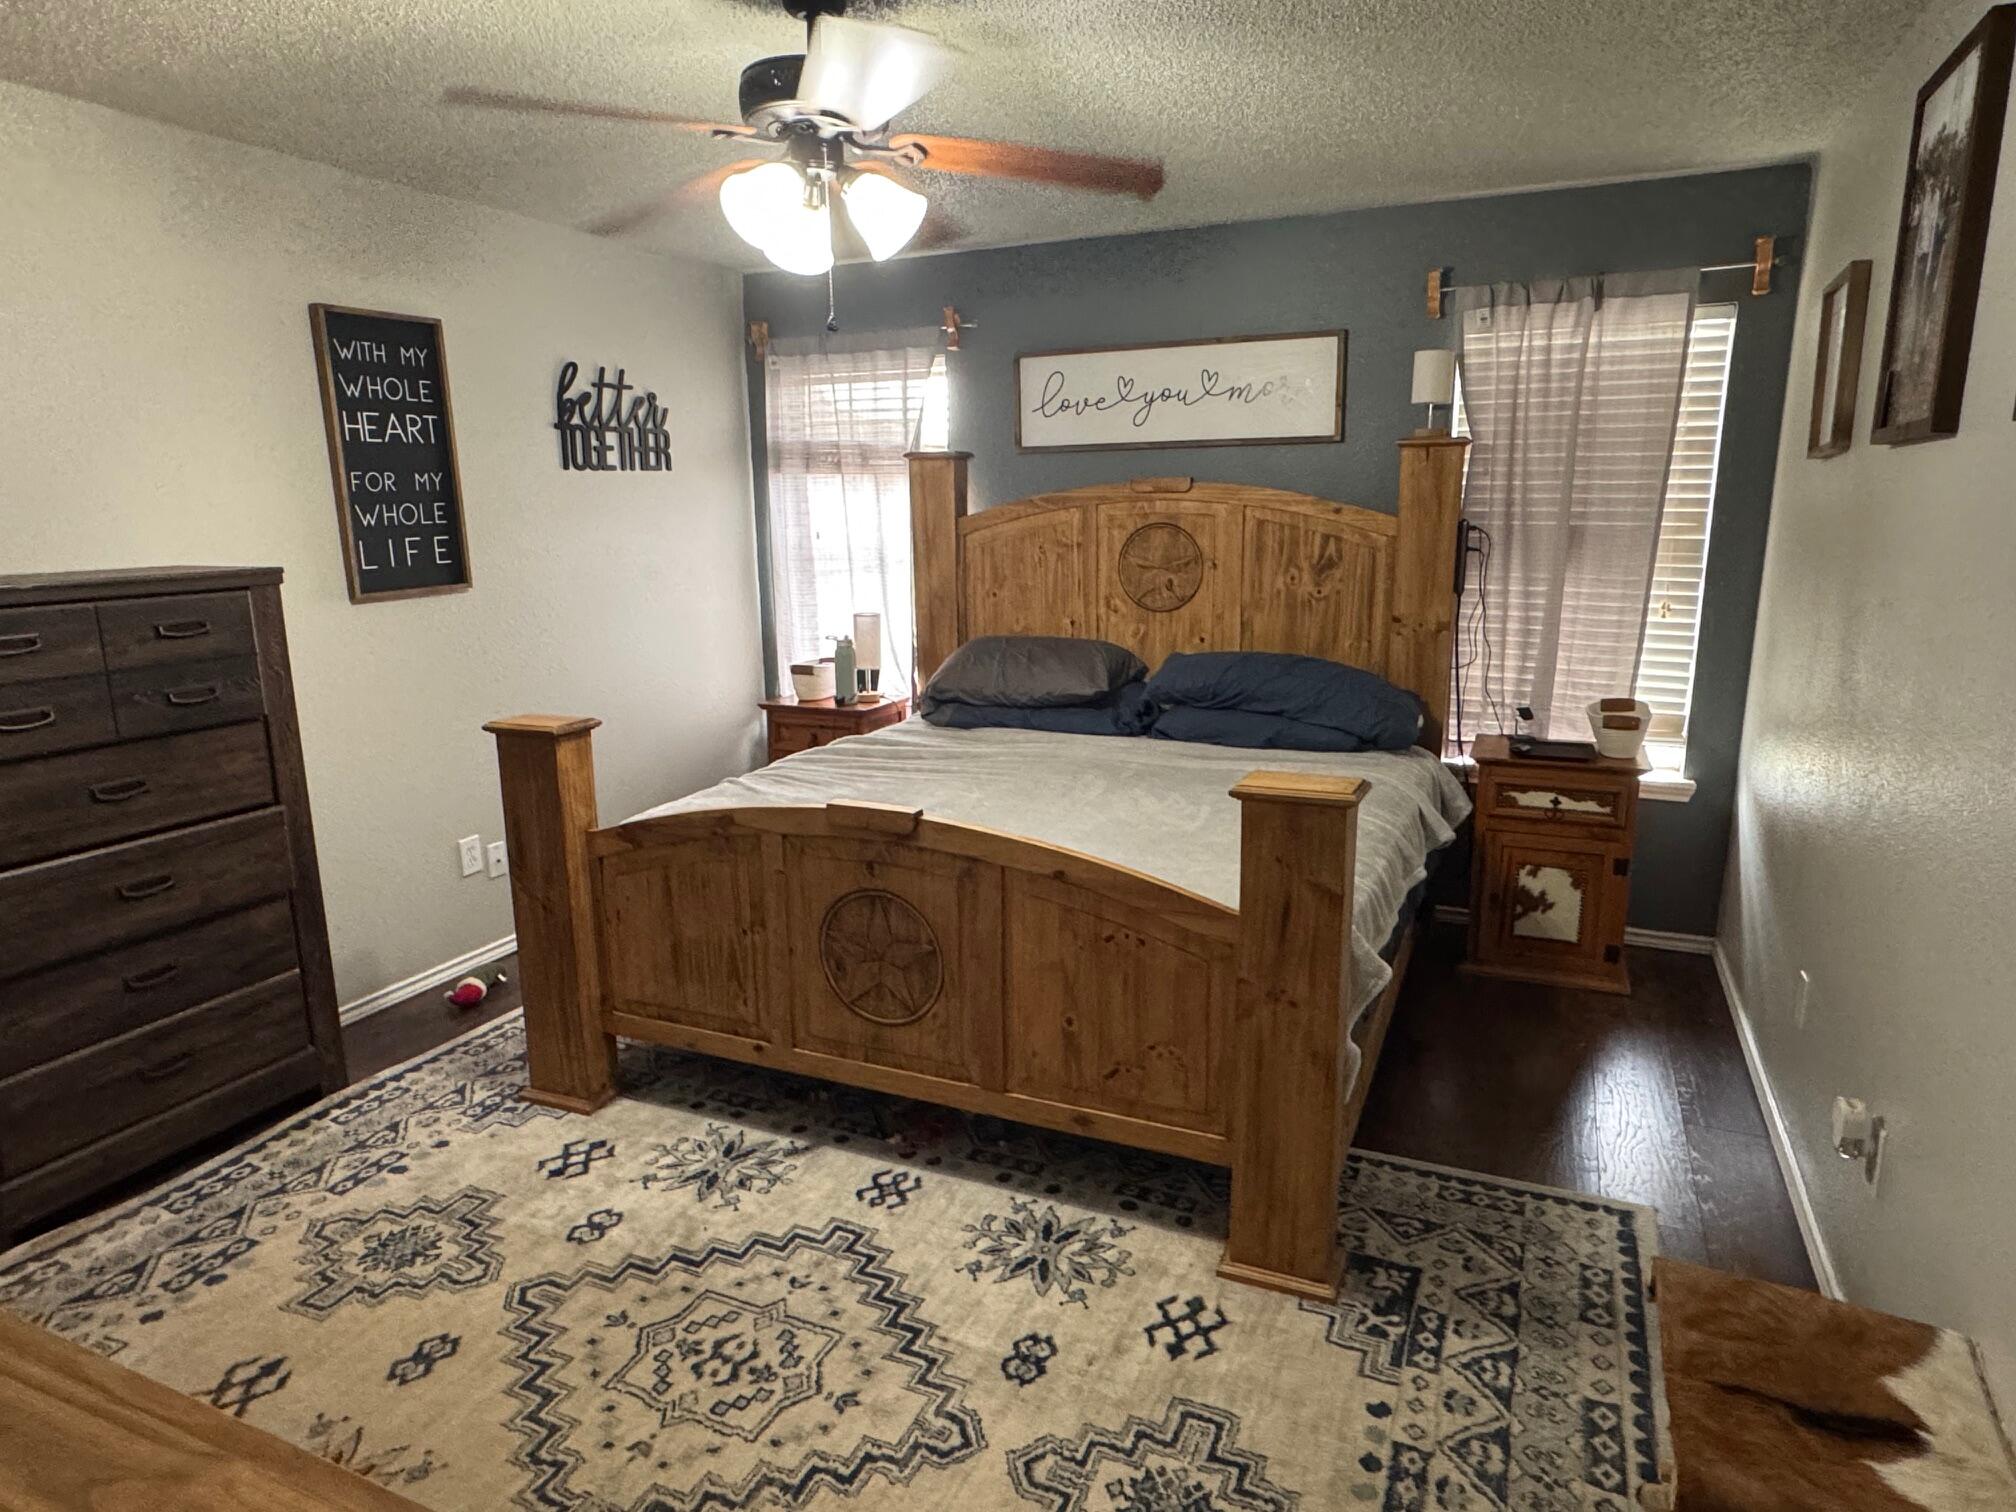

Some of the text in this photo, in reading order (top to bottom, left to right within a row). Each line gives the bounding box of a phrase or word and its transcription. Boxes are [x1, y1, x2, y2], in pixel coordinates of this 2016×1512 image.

[333, 338, 427, 367] WITH MY
[338, 373, 434, 403] WHOLE
[554, 361, 669, 430] better
[1032, 371, 1107, 418] love
[1133, 386, 1190, 427] you
[343, 410, 438, 444] HEART
[351, 472, 443, 492] FOR MY
[355, 503, 447, 527] WHOLE
[359, 536, 453, 570] LIFE
